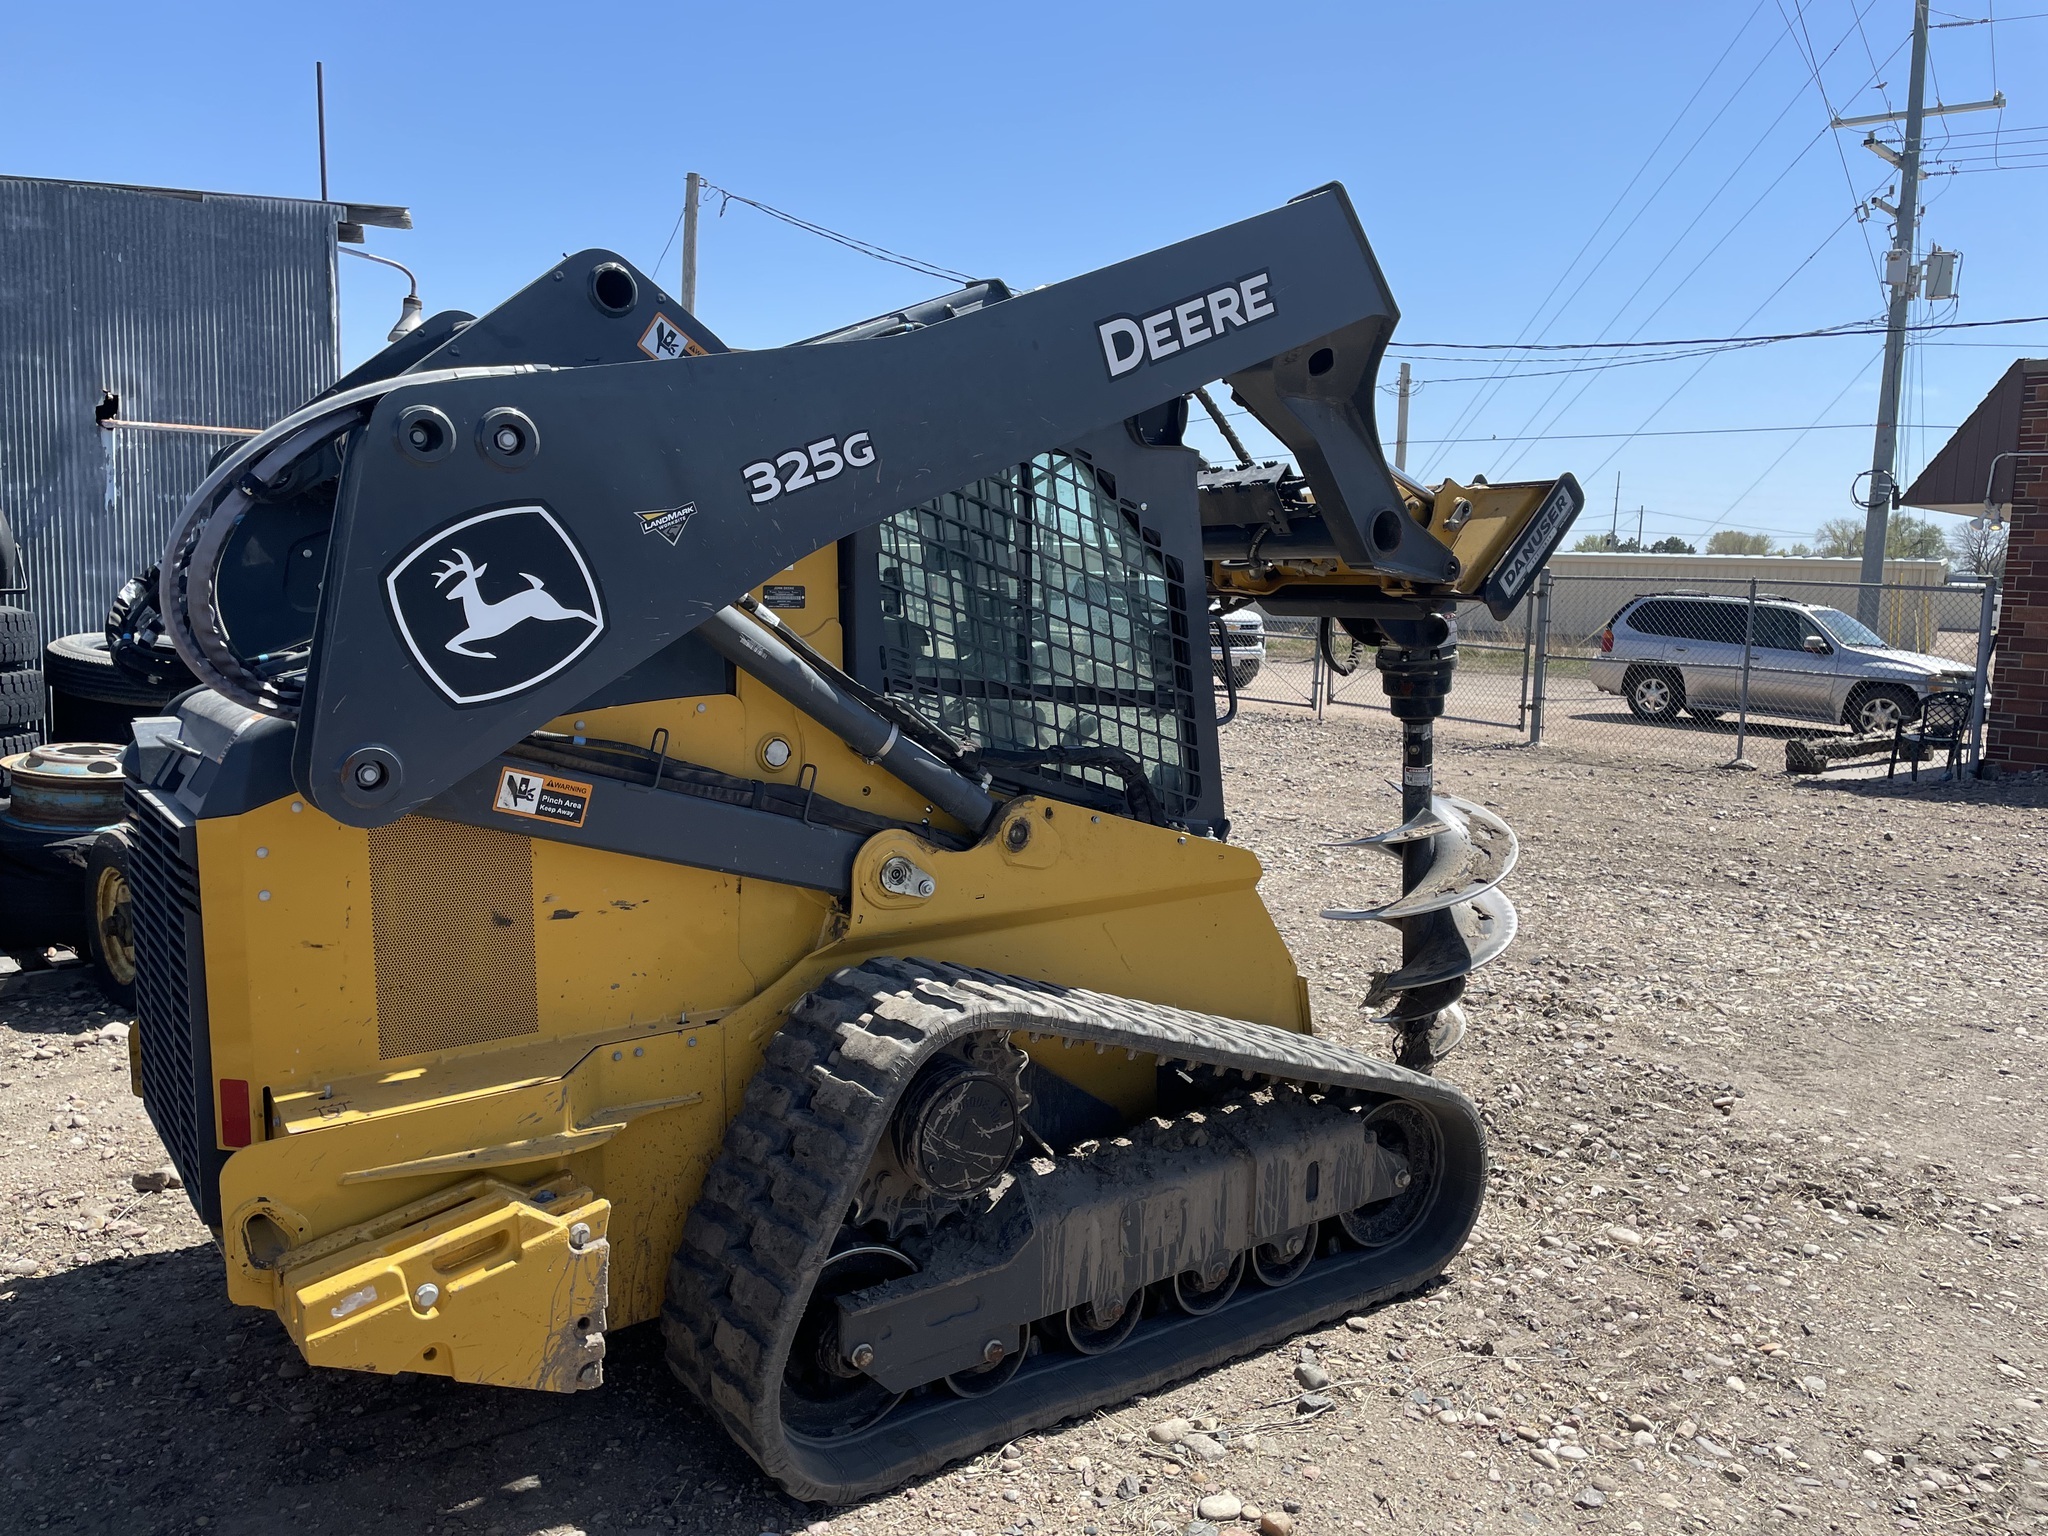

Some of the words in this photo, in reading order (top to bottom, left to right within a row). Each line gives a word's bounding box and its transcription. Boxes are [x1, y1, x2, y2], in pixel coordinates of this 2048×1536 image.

[1099, 273, 1275, 377] DEERE
[743, 431, 876, 503] 325G
[644, 505, 694, 530] LANDMARK
[658, 515, 686, 530] WORKSITE
[1504, 495, 1568, 588] DANUSER
[554, 781, 587, 794] WARNING
[539, 803, 556, 813] Keep
[556, 808, 574, 818] Away
[541, 794, 563, 806] Pinch
[564, 800, 582, 809] Area
